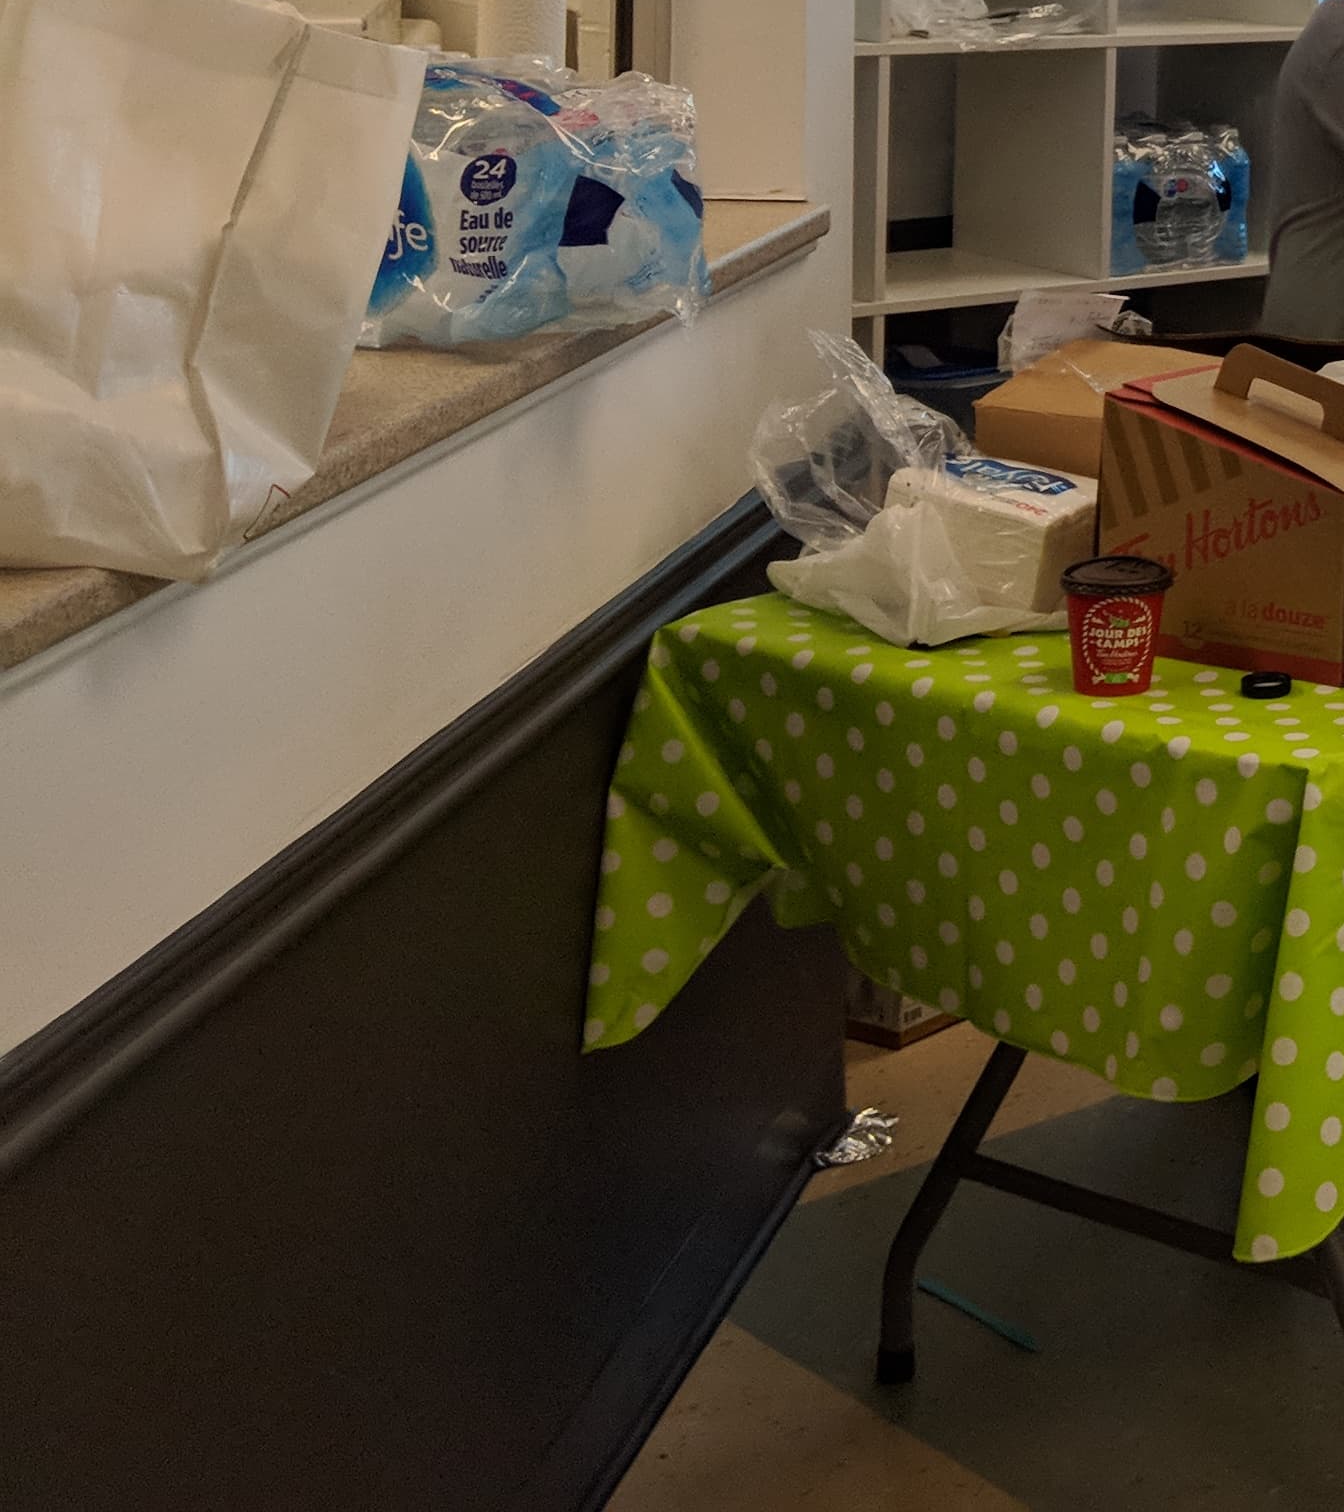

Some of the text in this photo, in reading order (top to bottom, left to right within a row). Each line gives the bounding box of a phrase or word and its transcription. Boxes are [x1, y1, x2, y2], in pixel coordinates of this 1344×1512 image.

[473, 158, 507, 180] 24
[460, 207, 514, 231] Eau de
[387, 209, 429, 260] fe
[459, 235, 508, 254] source
[1185, 489, 1322, 569] Hortons
[1262, 602, 1325, 629] douze
[1089, 627, 1146, 639] JOUR DES
[1096, 638, 1139, 648] CAMPS
